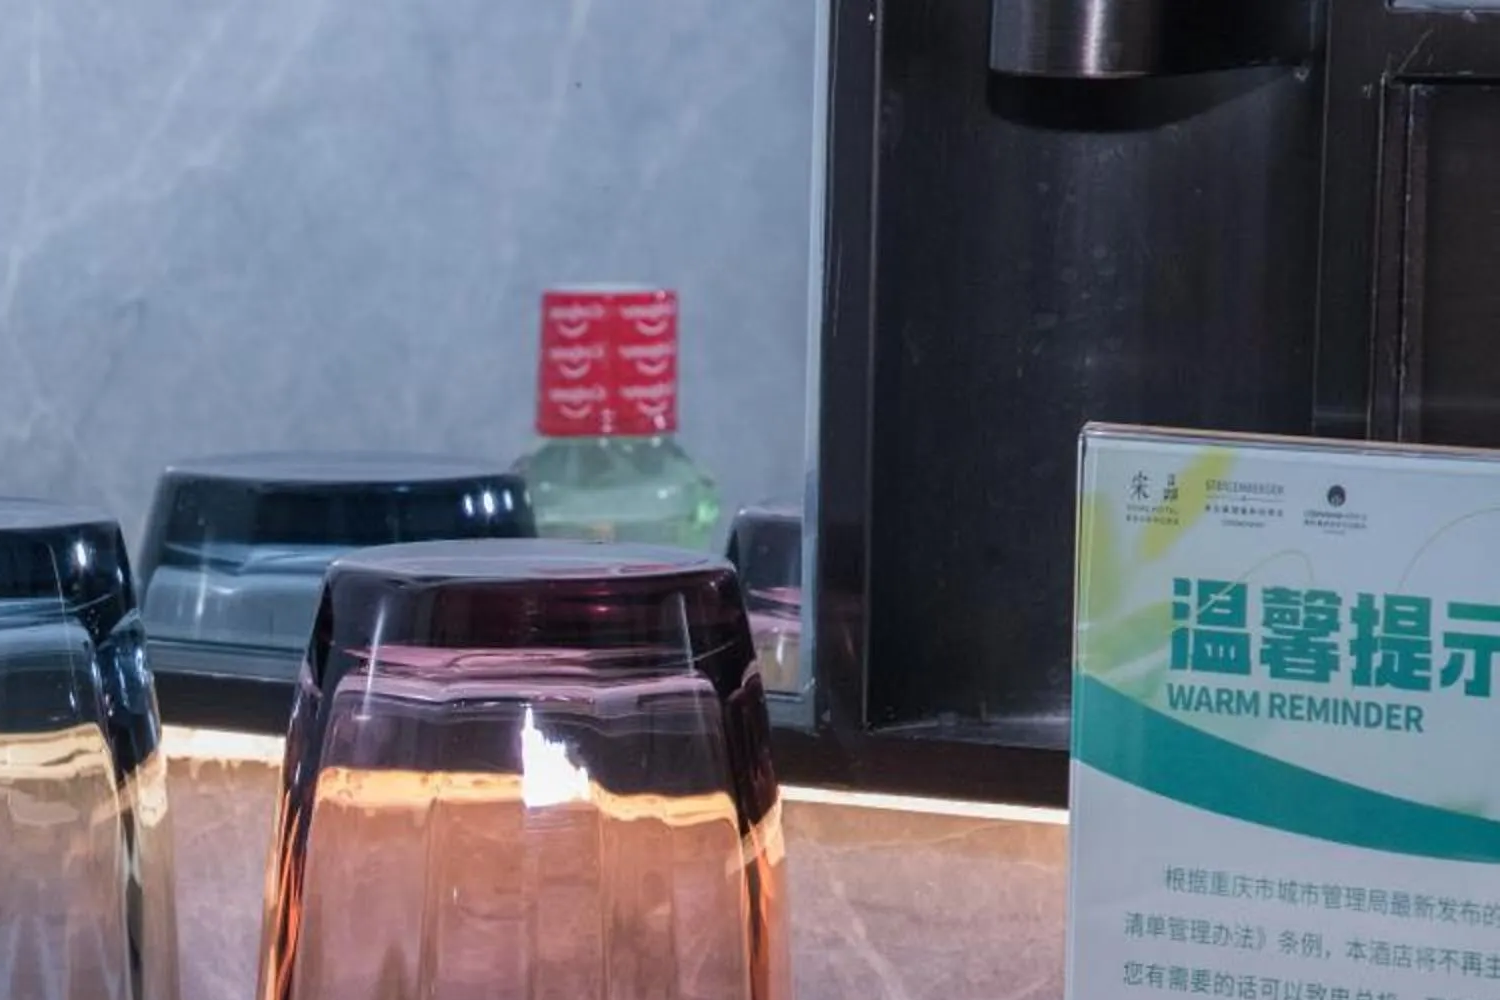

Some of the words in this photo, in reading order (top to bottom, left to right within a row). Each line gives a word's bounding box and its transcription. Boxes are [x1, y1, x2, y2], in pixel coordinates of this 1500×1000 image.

[1170, 577, 1500, 698] 温馨提示
[1167, 683, 1260, 718] WARM
[1268, 692, 1424, 733] REMINDER
